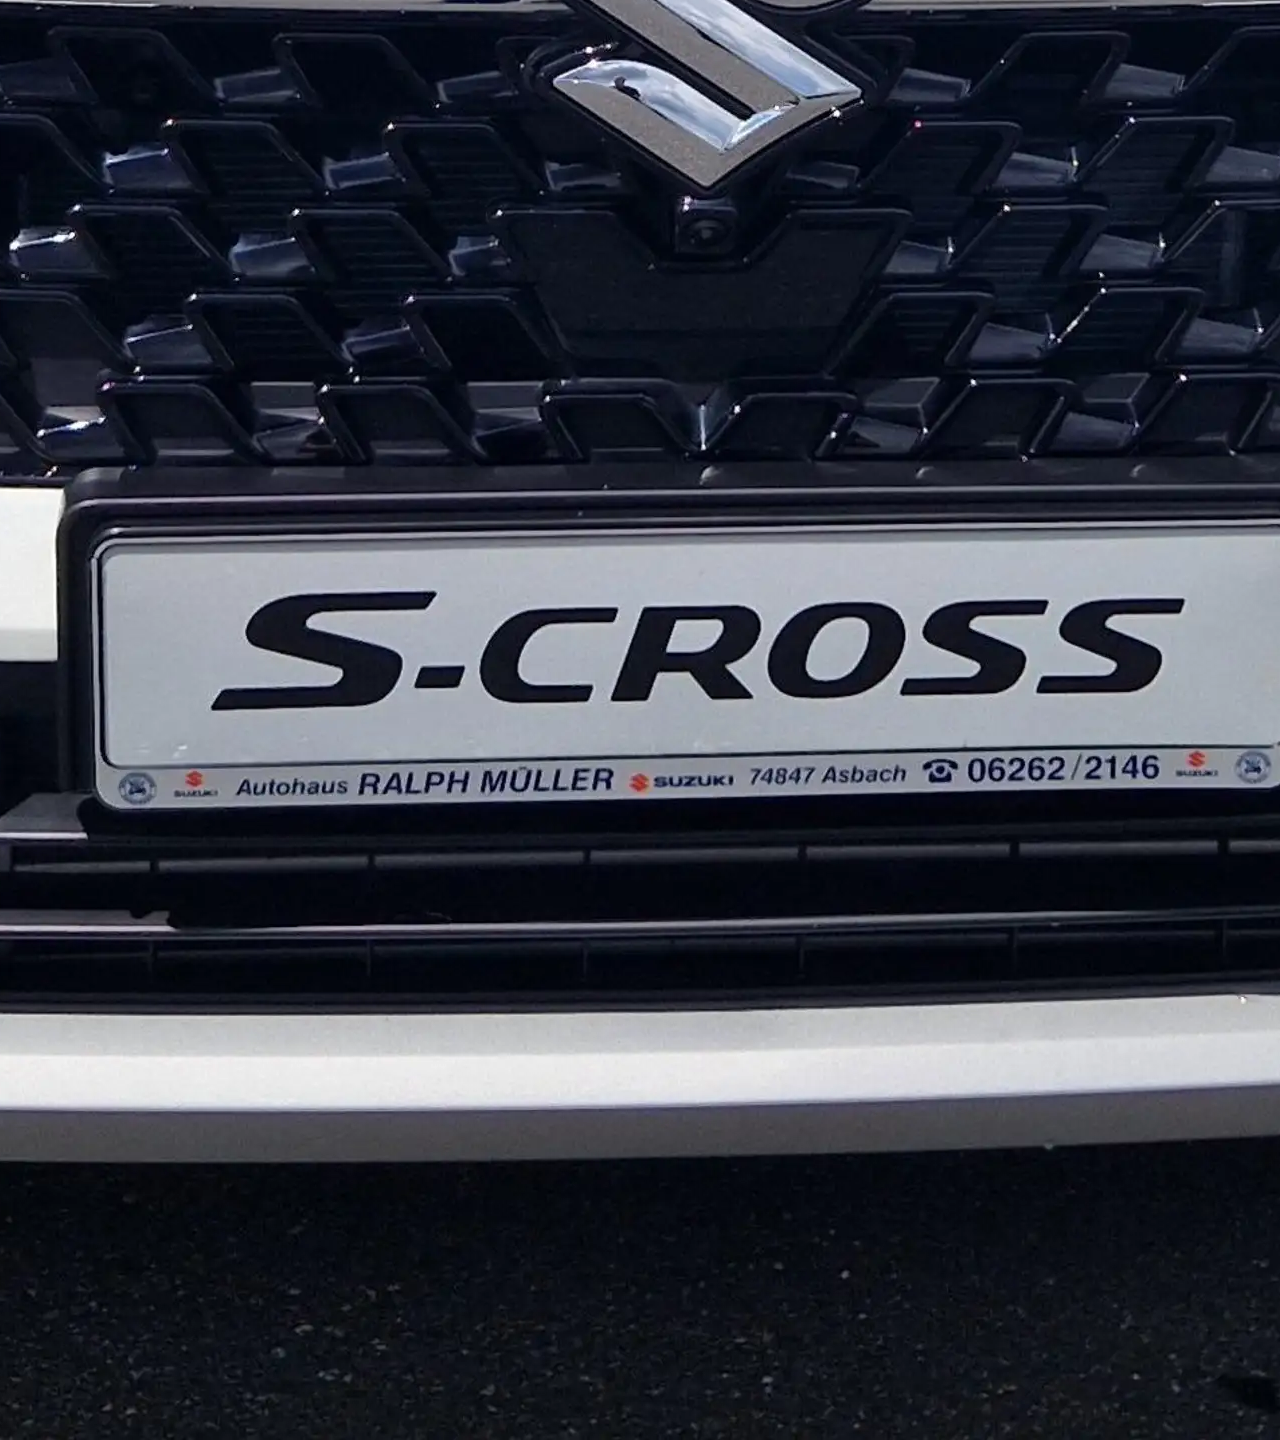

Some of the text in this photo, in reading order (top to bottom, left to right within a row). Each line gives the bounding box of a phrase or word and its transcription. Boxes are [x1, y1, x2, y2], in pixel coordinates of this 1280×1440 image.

[211, 591, 1184, 710] S-CROSS
[235, 777, 349, 797] Autohaus
[357, 770, 470, 796] RALPH
[480, 765, 615, 794] MÜLLER
[653, 774, 734, 789] SUZUKI
[750, 767, 816, 786] 74847
[821, 764, 907, 784] Asbach
